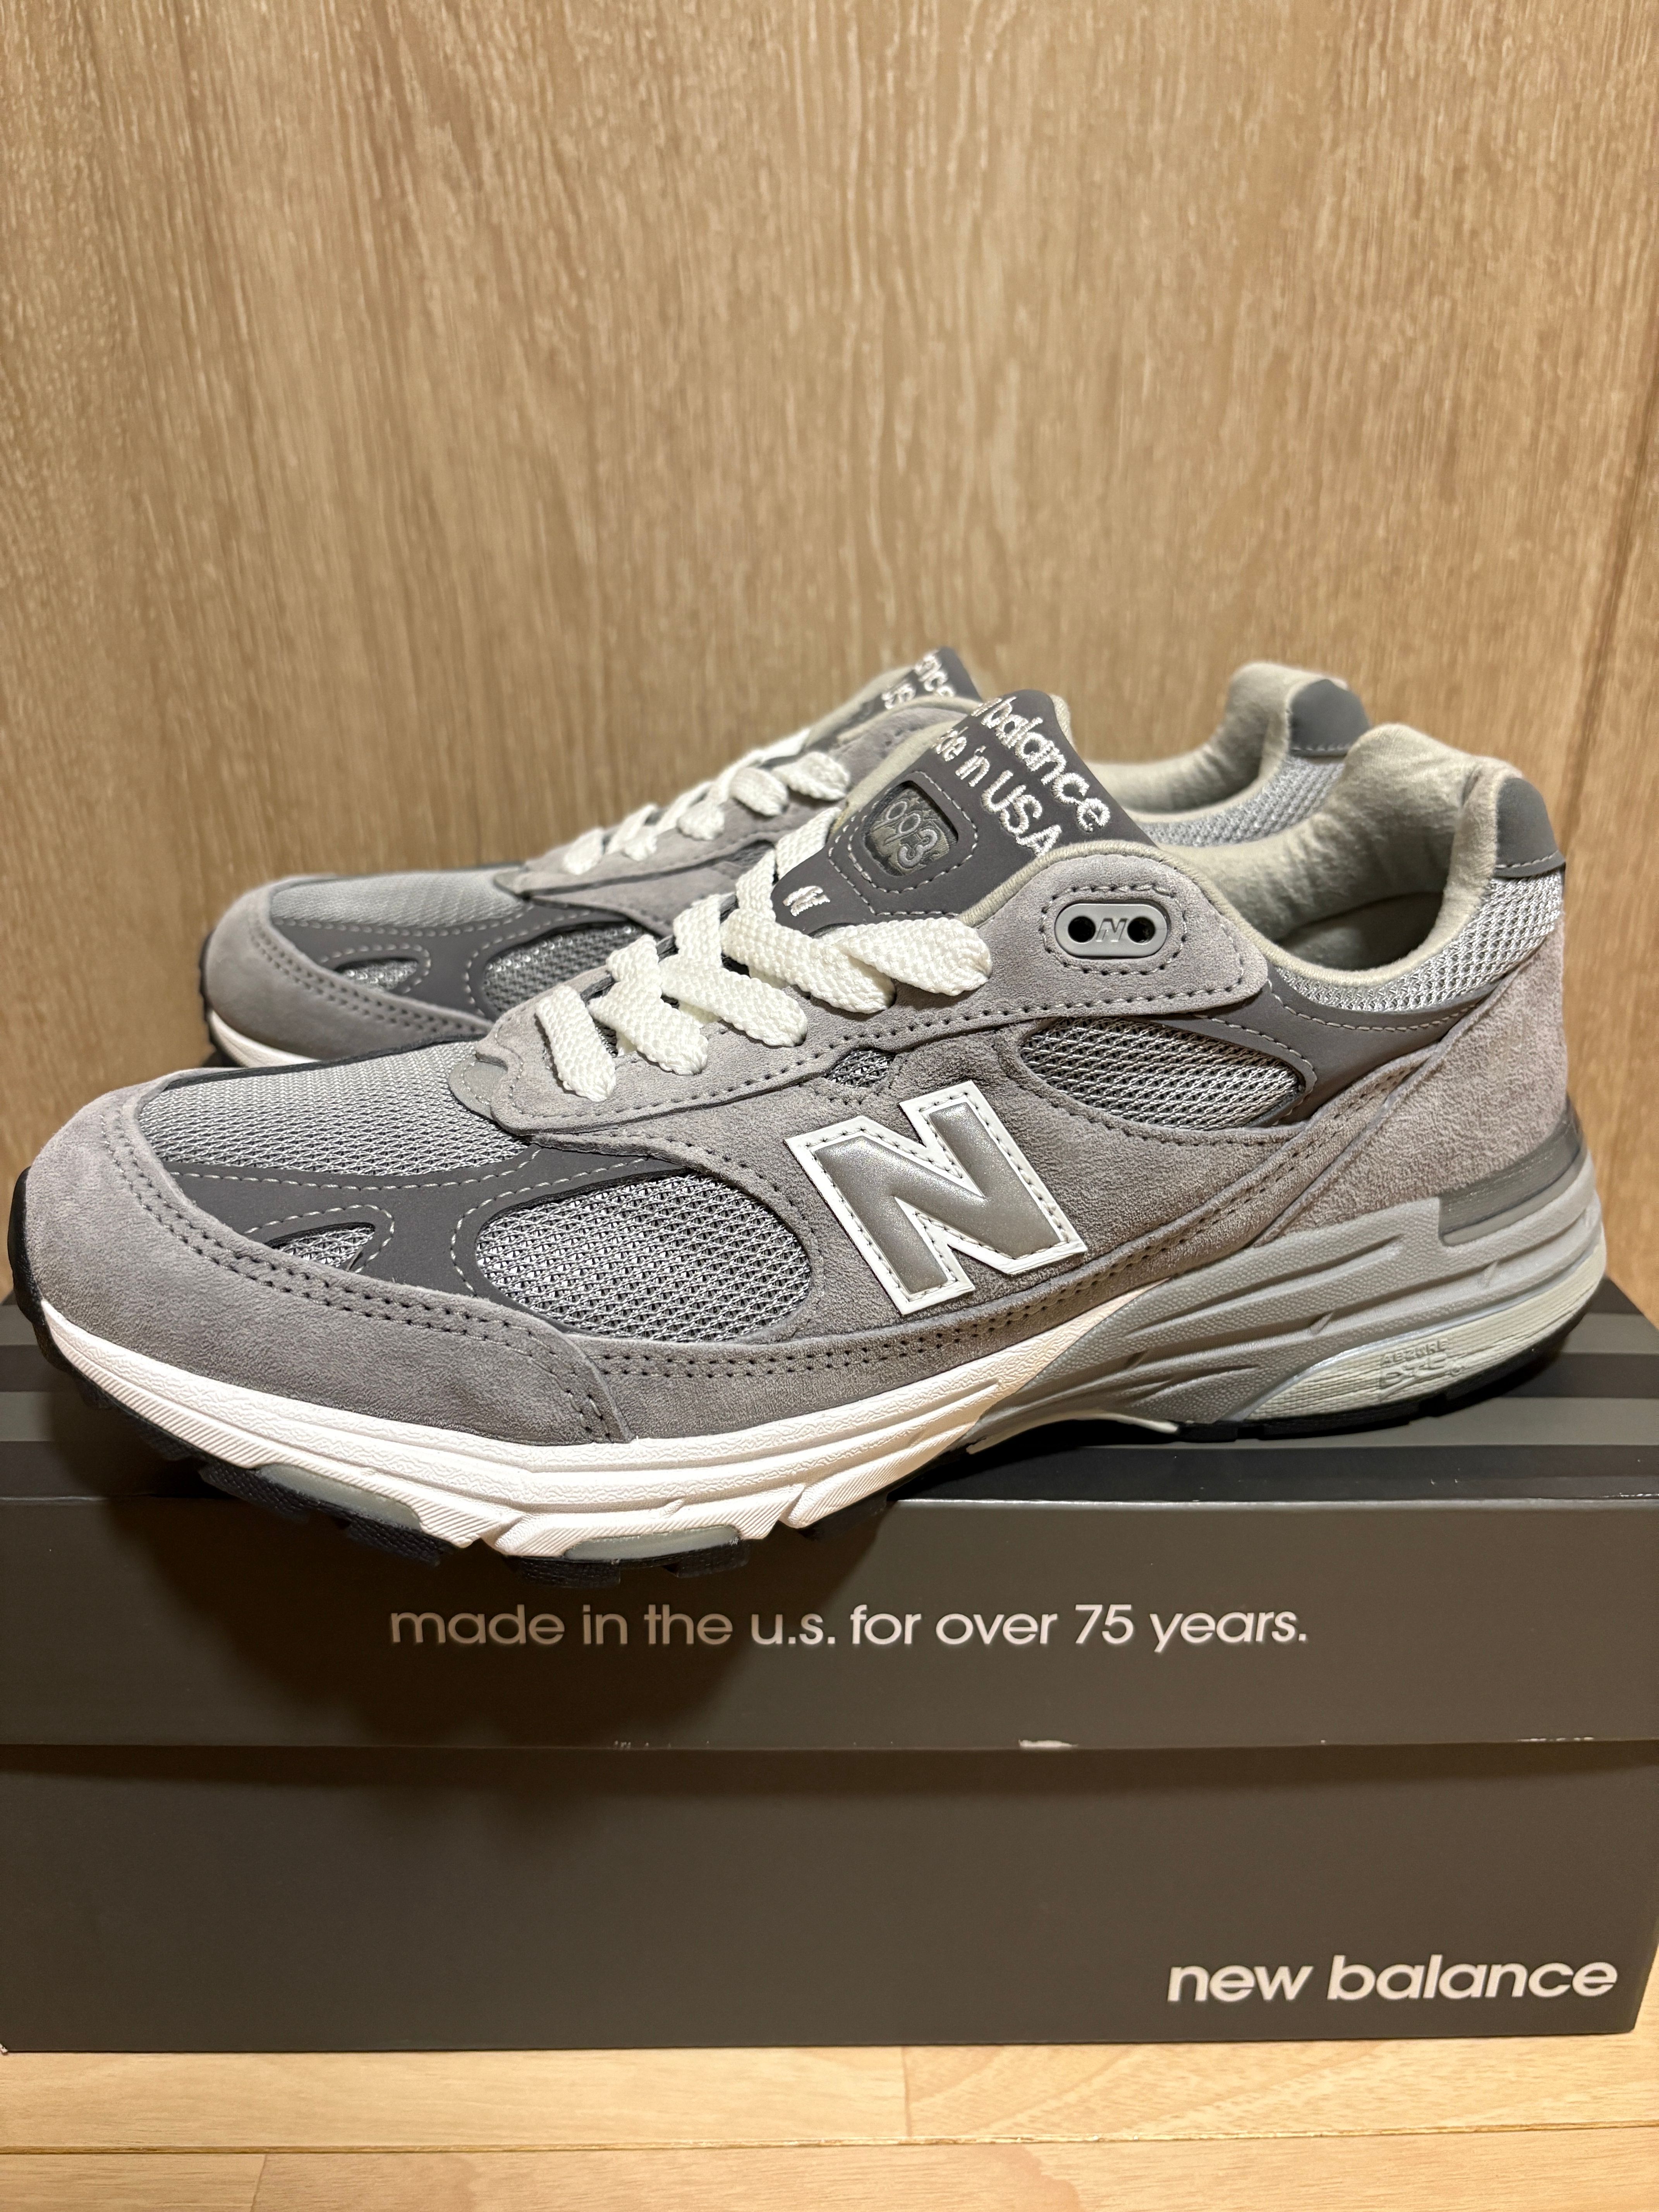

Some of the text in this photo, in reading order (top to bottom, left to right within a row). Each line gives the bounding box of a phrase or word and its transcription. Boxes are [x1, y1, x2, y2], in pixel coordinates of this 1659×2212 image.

[981, 696, 1111, 832] balance
[871, 800, 938, 867] 993
[955, 745, 990, 787] in
[981, 769, 1063, 857] USA
[1095, 917, 1128, 943] N
[785, 1080, 1088, 1316] N
[391, 1603, 1307, 1654] made in the u.s. for over 75 years.
[1167, 1954, 1618, 2002] new balance
